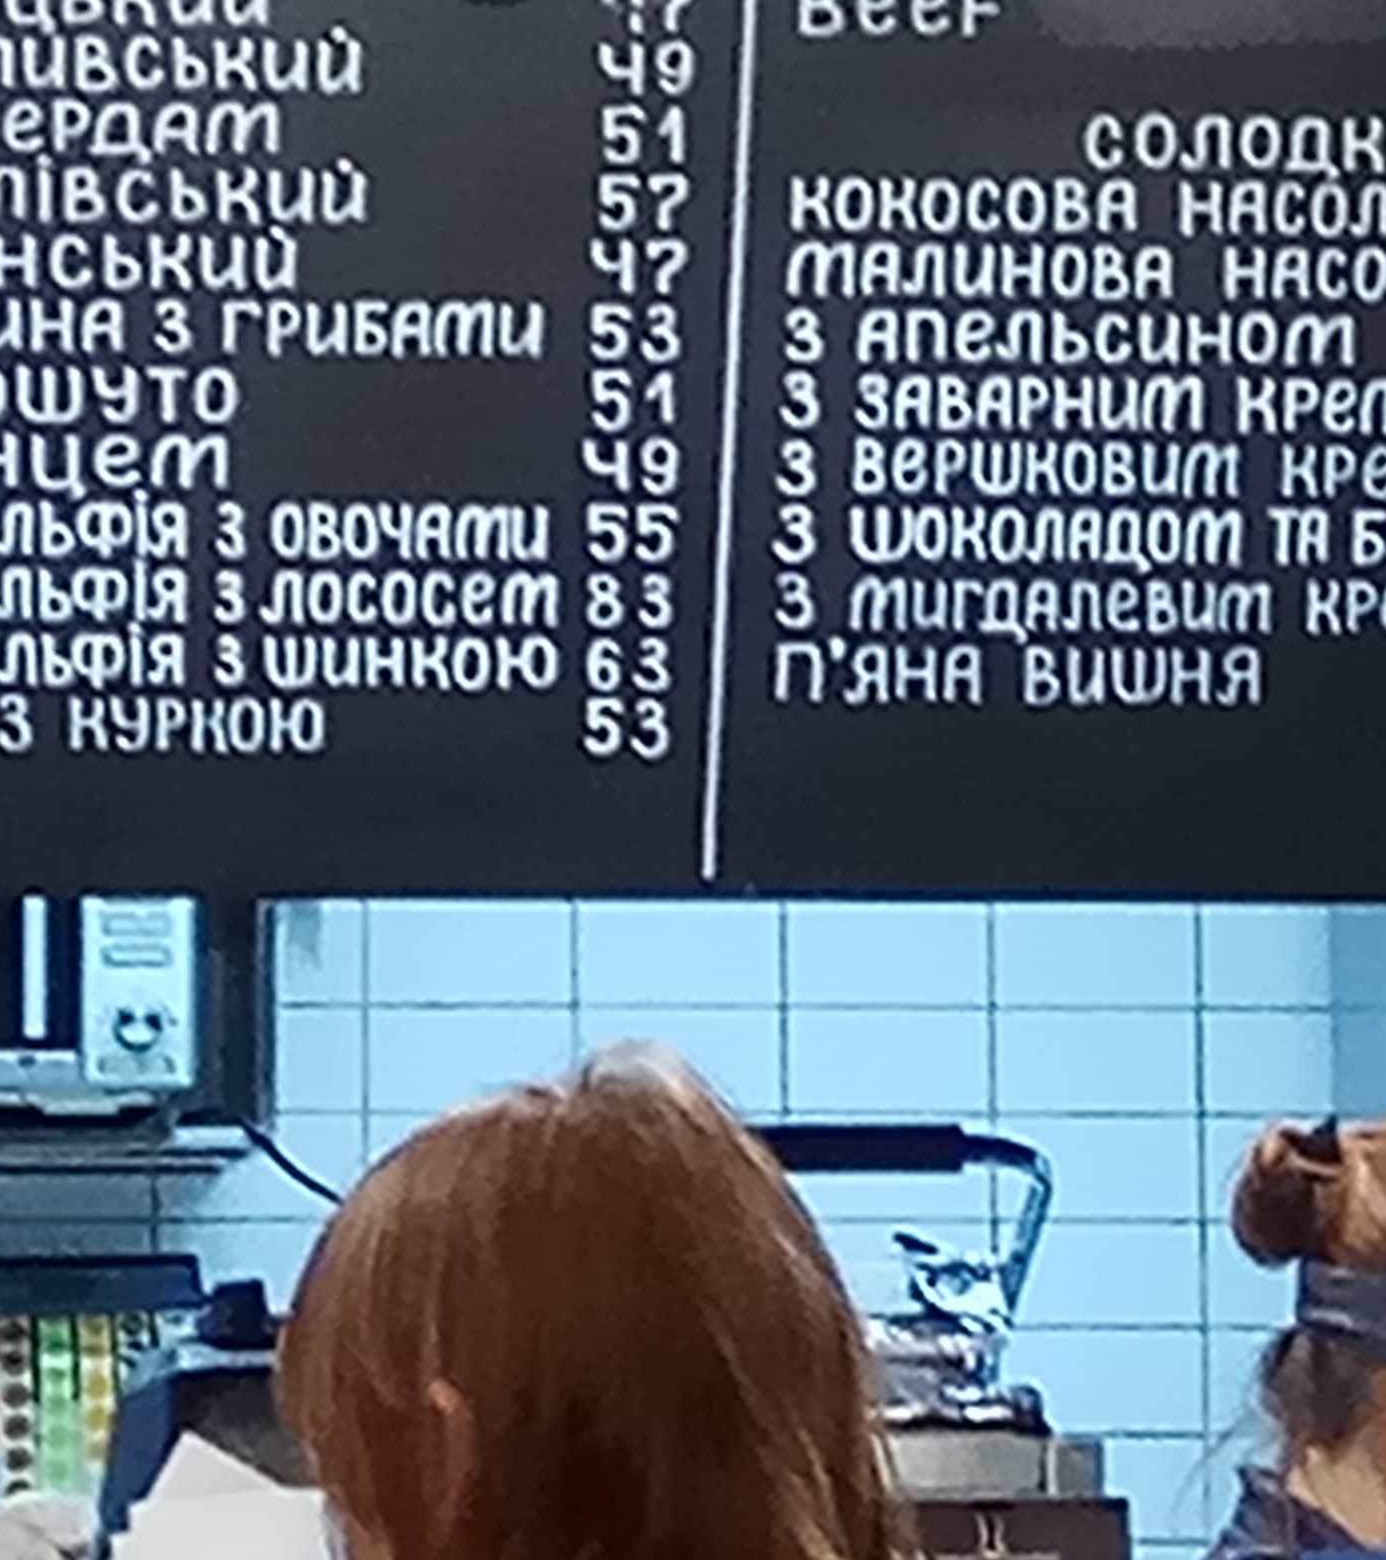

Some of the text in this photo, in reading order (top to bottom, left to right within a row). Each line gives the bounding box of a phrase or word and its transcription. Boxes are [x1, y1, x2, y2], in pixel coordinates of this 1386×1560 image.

[598, 39, 695, 97] 49
[601, 102, 685, 165] 51
[598, 172, 690, 232] 57
[789, 175, 1138, 235] КОКОСОВА
[589, 237, 689, 295] 47
[785, 239, 1174, 302] МАЛИНОВА
[153, 297, 193, 355] З
[221, 298, 545, 359] ГРИБАМИ
[589, 302, 682, 364] 53
[784, 306, 825, 364] З
[855, 307, 1355, 367] АПЕЛЬСИНОМ
[591, 367, 676, 433] 51
[779, 369, 821, 430] З
[853, 372, 1204, 434] ЗАВАРНИМ
[581, 436, 680, 497] 49
[774, 438, 817, 497] З
[851, 434, 1240, 500] ВЕРШКОВИМ
[214, 500, 247, 560] З
[270, 500, 550, 562] ОВОЧАМИ
[586, 501, 680, 564] 55
[771, 502, 817, 565] З
[848, 504, 1244, 575] ШОКОЛАДОМ
[1266, 506, 1330, 567] ТА
[213, 568, 247, 625] З
[258, 568, 560, 628] ЛОСОСЕМ
[585, 572, 673, 630] 83
[774, 571, 816, 630] З
[848, 574, 1272, 645] МИГДАЛЕВИМ
[213, 632, 247, 687] З
[262, 634, 559, 692] ШИНКОЮ
[585, 635, 672, 693] 63
[1023, 644, 1261, 706] ВИШНЯ
[68, 695, 325, 754] КУРКОЮ
[583, 696, 670, 760] 53
